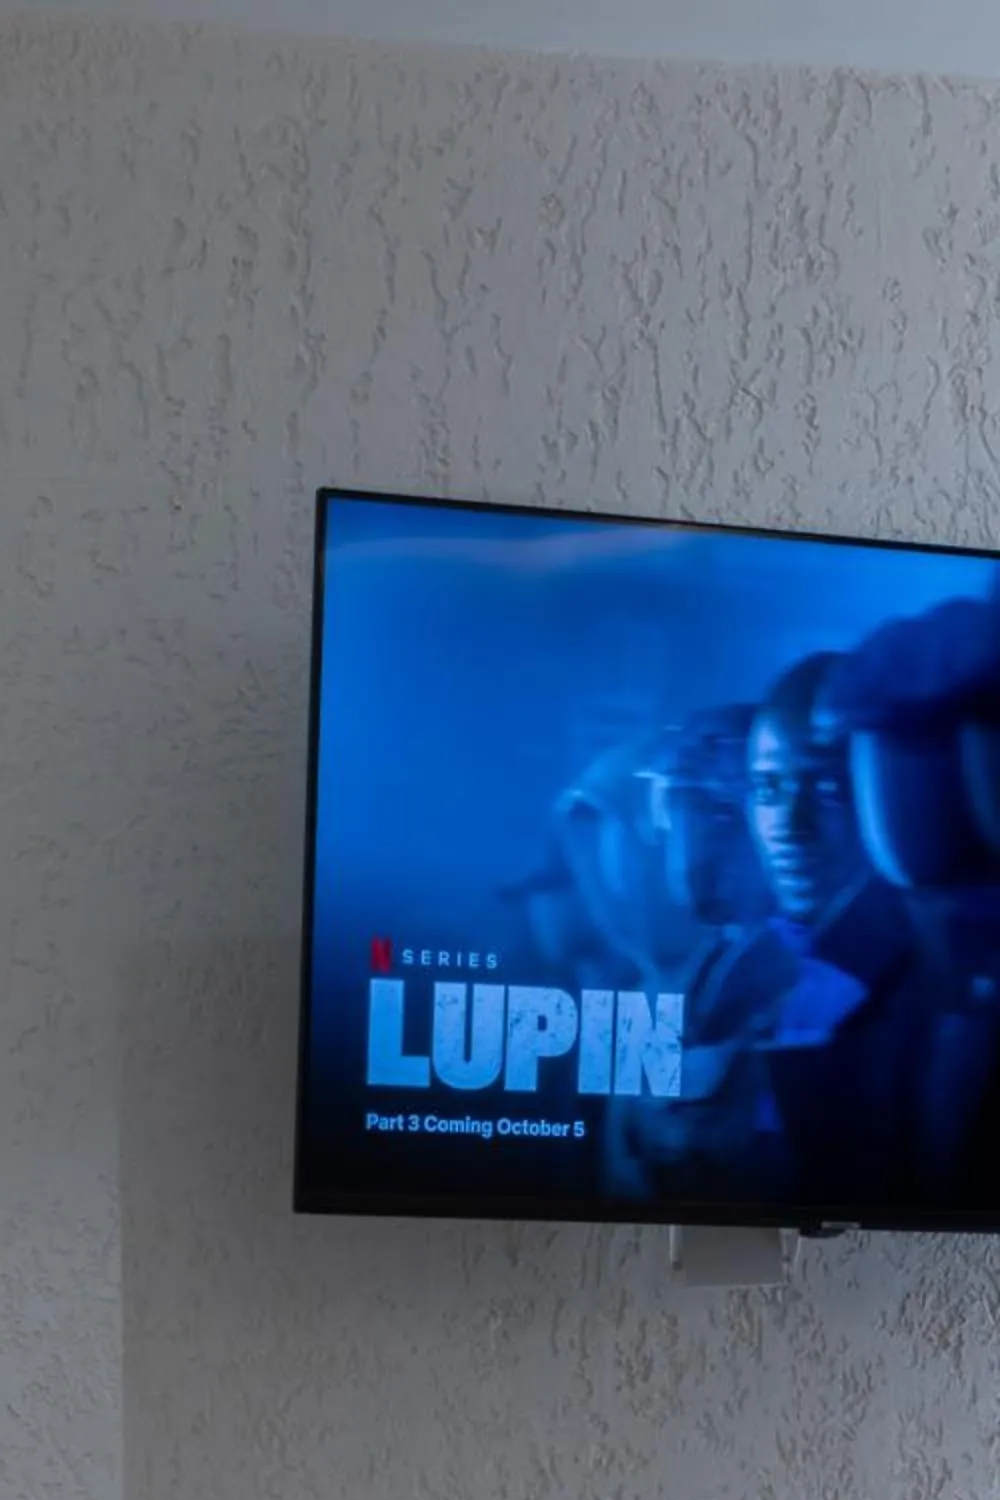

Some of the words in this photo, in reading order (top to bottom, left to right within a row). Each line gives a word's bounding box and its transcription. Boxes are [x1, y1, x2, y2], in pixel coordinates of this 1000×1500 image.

[402, 948, 498, 969] SERIES
[366, 977, 685, 1097] LUPIN
[365, 1112, 404, 1131] Part
[408, 1114, 420, 1132] 3
[424, 1115, 493, 1138] Coming
[497, 1117, 571, 1138] October
[574, 1120, 585, 1138] 5
